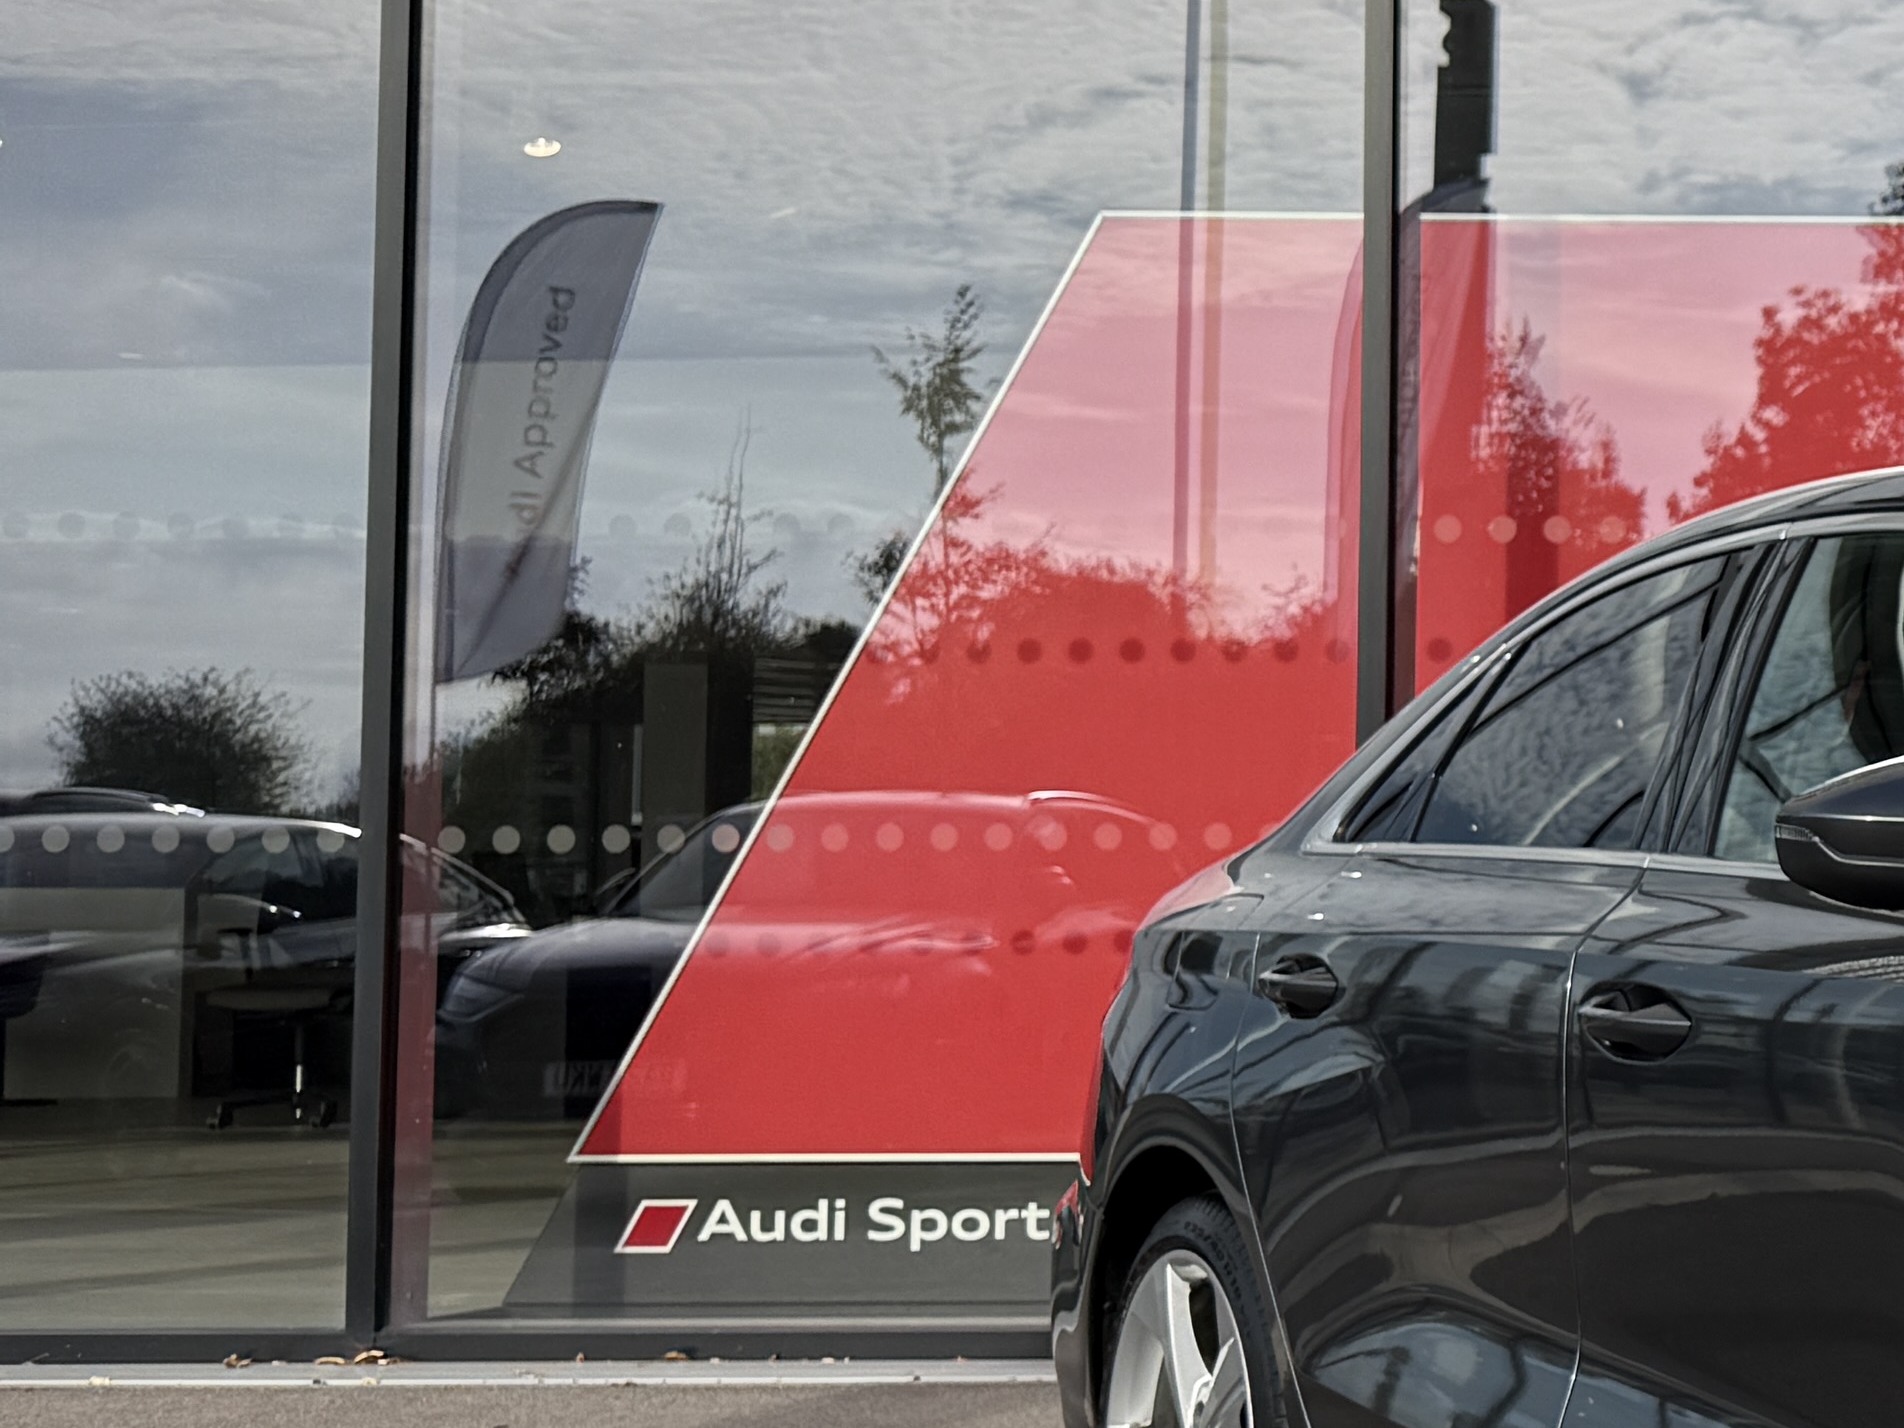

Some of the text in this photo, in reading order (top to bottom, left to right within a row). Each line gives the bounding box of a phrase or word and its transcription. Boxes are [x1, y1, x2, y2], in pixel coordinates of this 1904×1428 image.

[513, 285, 576, 479] Approved
[698, 1197, 1051, 1252] Audi Sport
